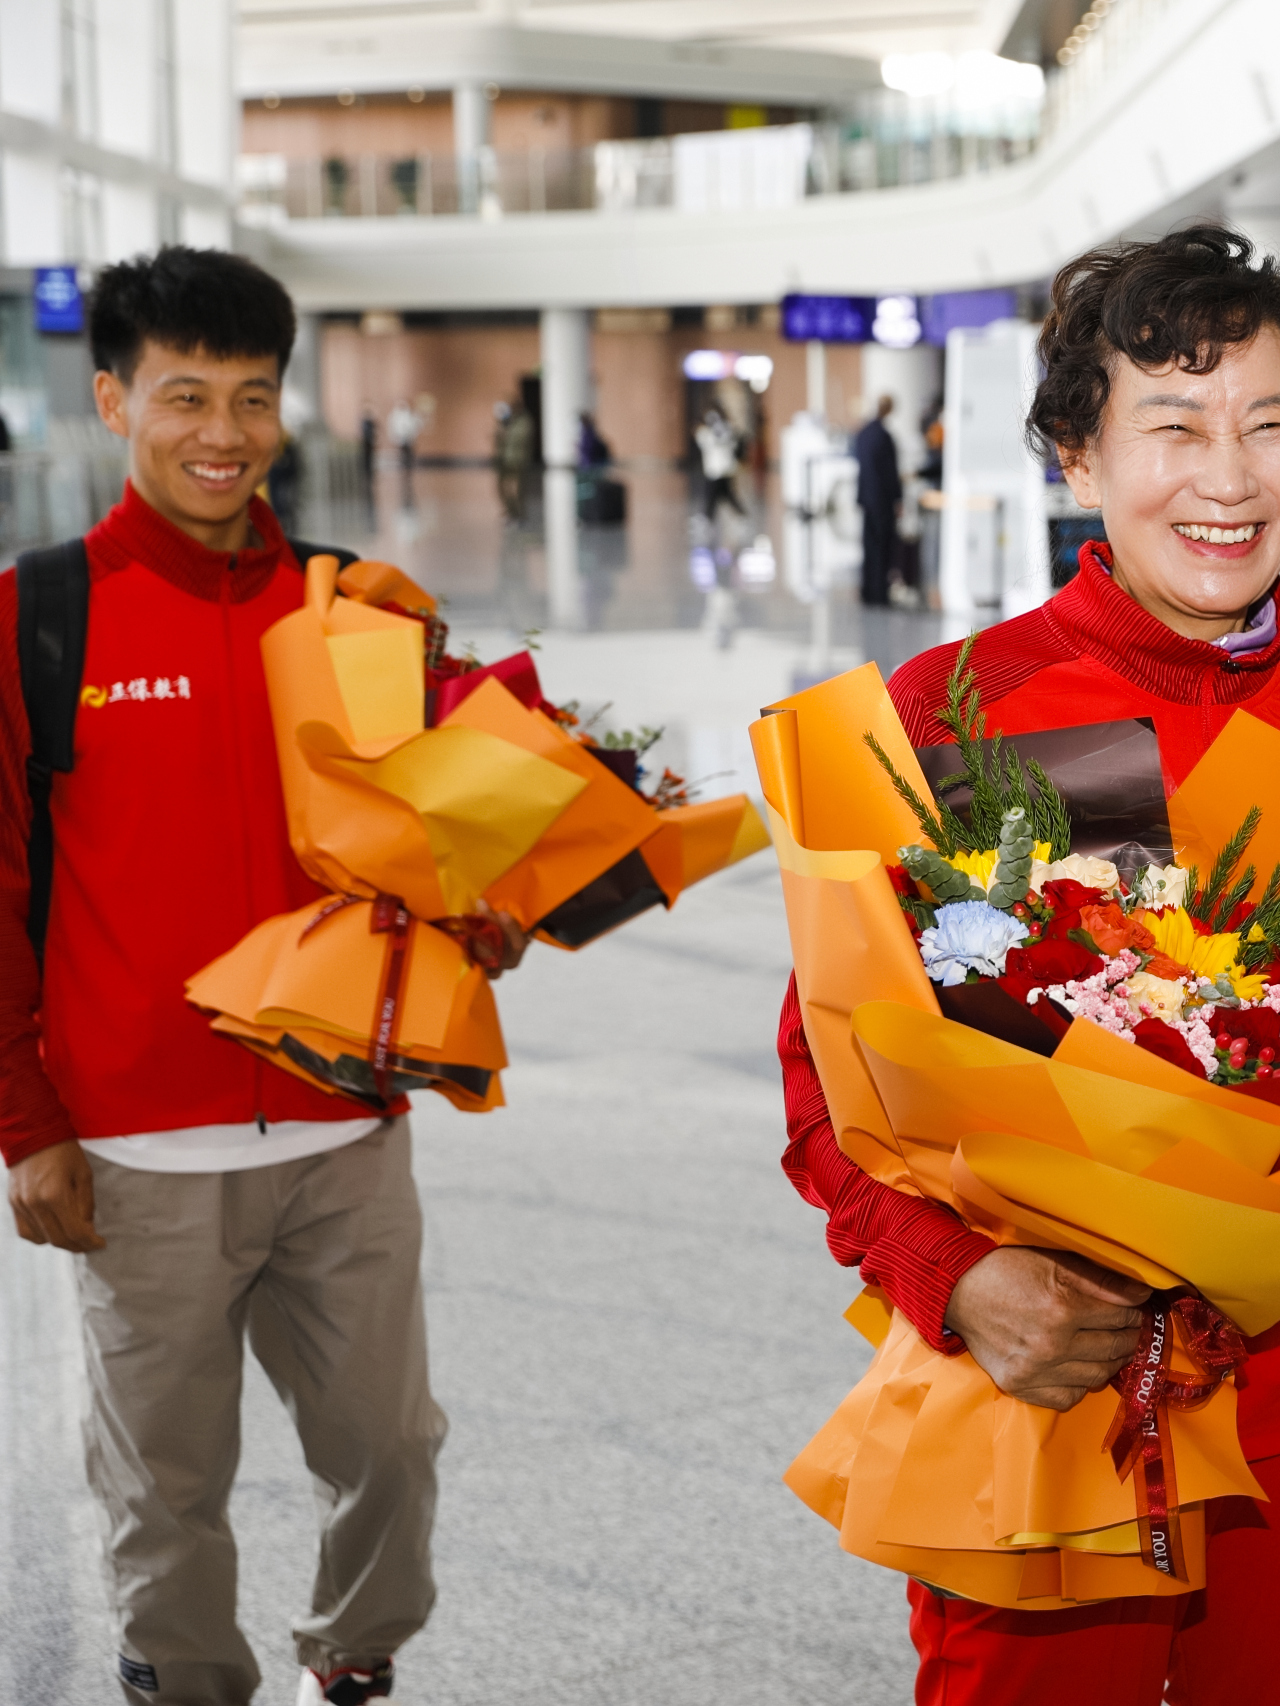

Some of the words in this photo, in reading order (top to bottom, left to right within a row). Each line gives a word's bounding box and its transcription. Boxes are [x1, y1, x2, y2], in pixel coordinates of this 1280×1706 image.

[108, 674, 191, 703] 正保教育
[1154, 1313, 1165, 1332] ST
[1147, 1332, 1164, 1364] FOR
[1136, 1369, 1157, 1404] YOU
[1152, 1531, 1167, 1558] YOU
[1156, 1560, 1170, 1574] OR
